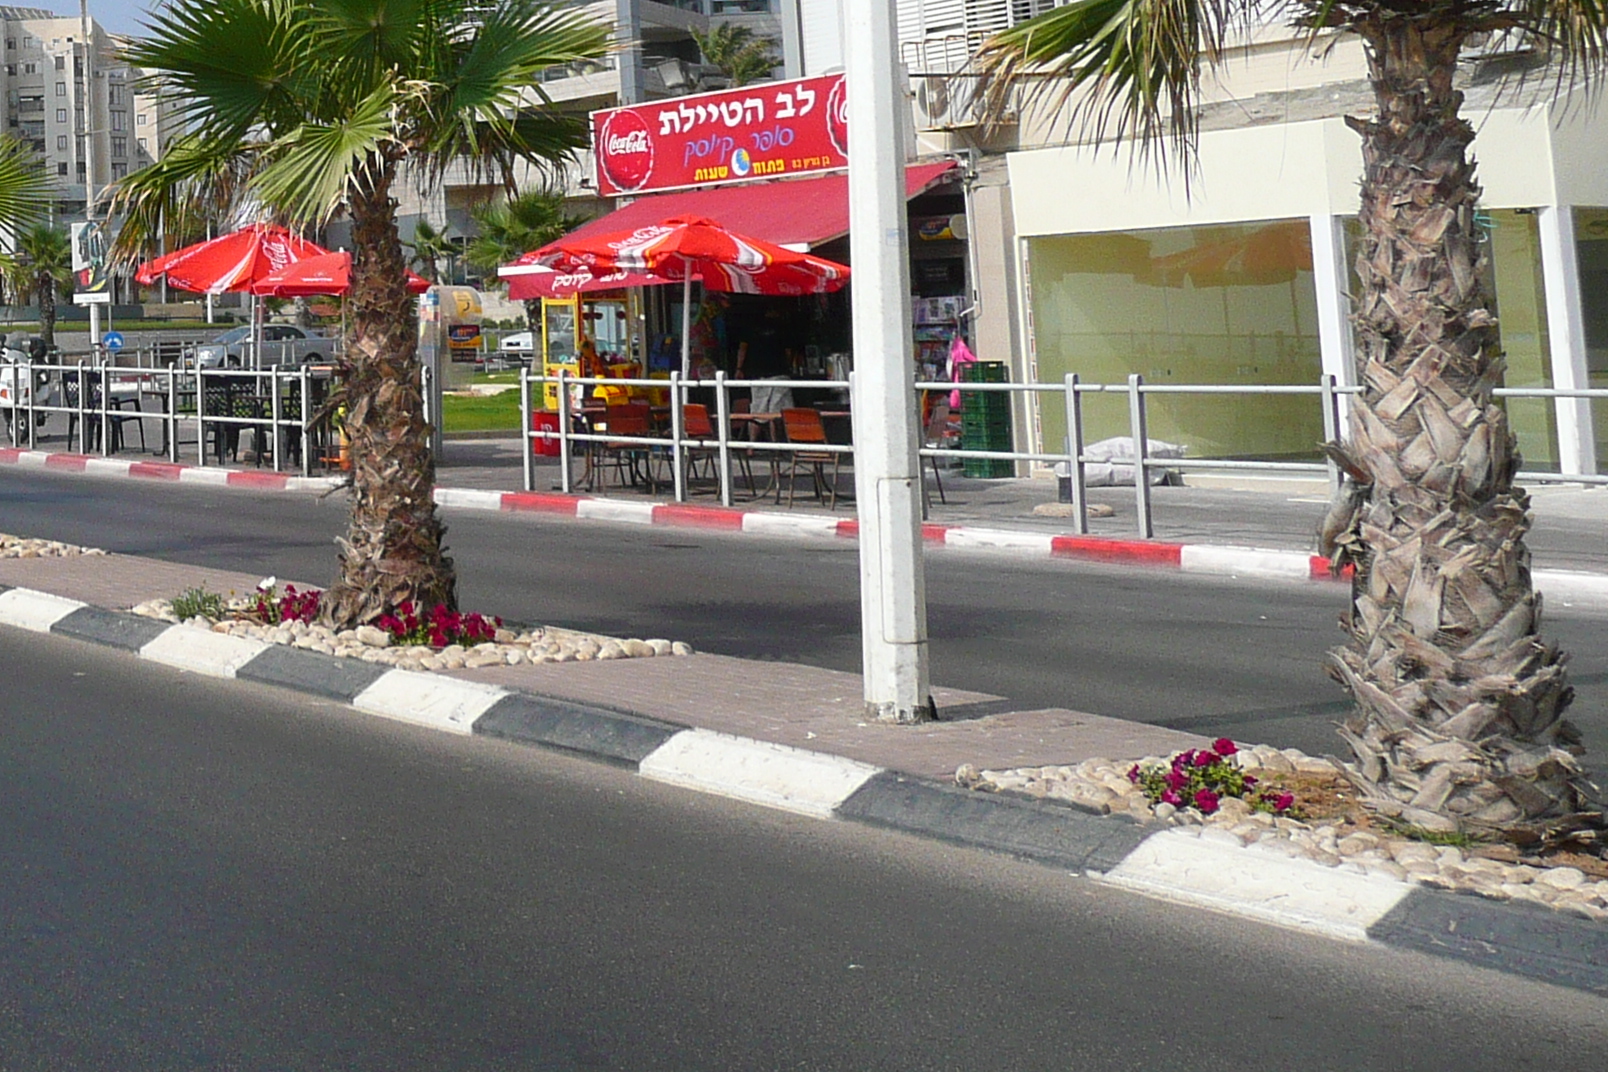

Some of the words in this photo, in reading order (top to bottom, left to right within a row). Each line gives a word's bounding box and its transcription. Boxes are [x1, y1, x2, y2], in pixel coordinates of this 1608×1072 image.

[775, 83, 815, 119] לב
[658, 98, 764, 136] הטיילת
[684, 134, 734, 167] קיוסק
[751, 124, 794, 151] סופר
[694, 166, 728, 181] שעות
[753, 159, 785, 174] פתוח
